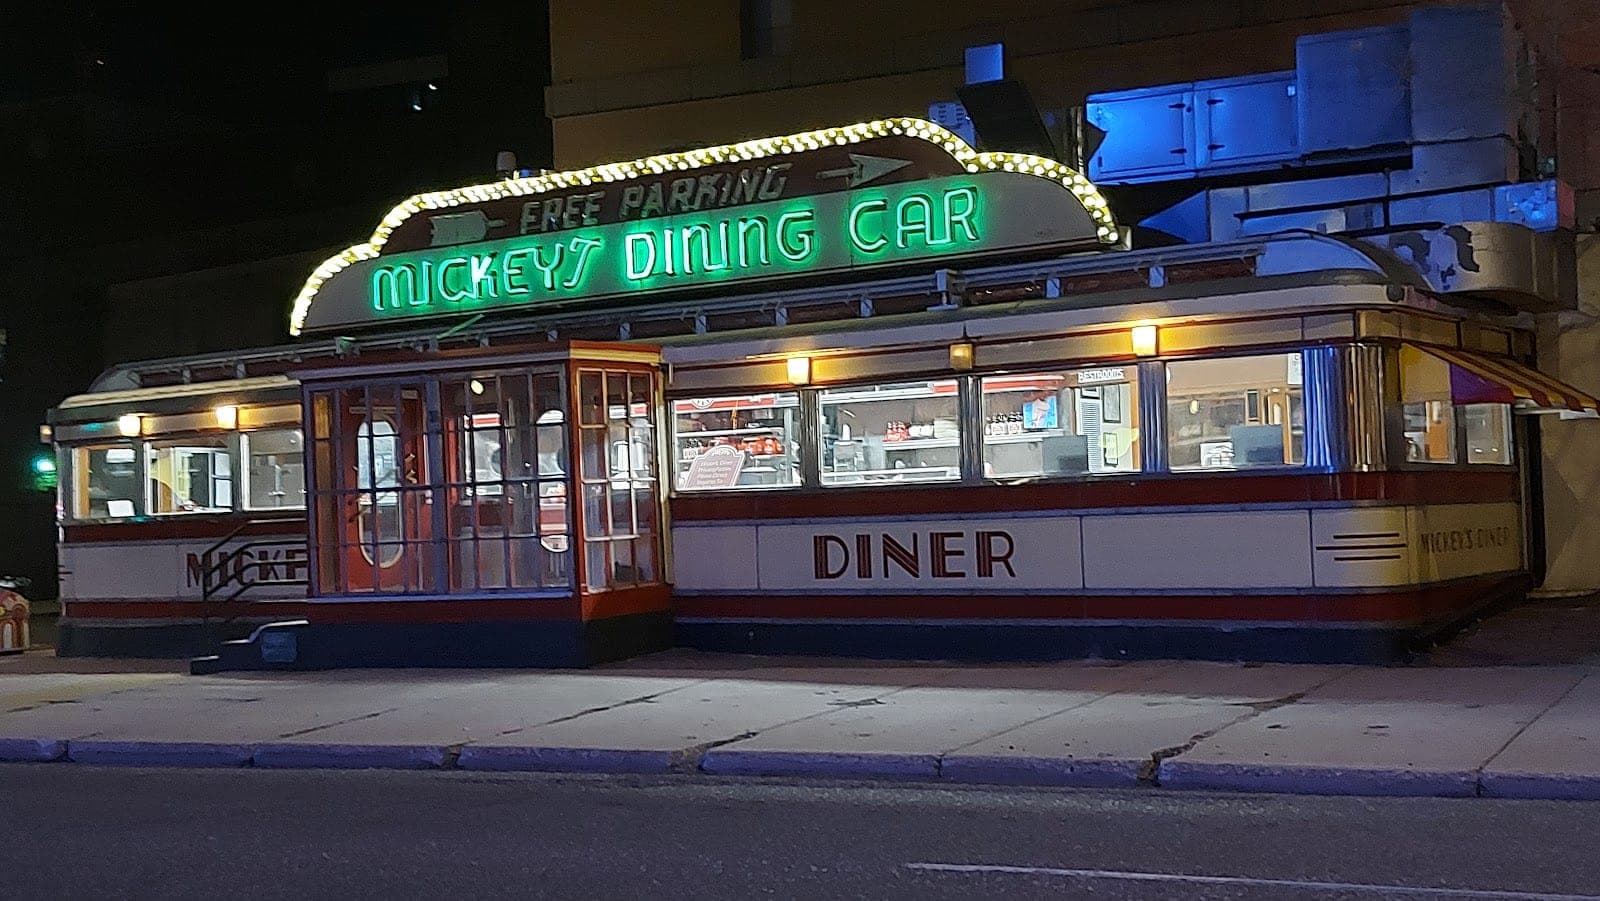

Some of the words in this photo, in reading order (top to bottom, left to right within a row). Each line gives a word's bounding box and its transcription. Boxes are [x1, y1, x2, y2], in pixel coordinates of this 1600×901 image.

[520, 192, 605, 235] FREE
[618, 164, 792, 219] PARKING
[624, 209, 816, 284] DINING
[848, 186, 979, 254] CAR
[1078, 369, 1124, 383] RESTROOMS
[813, 531, 1016, 580] DINER
